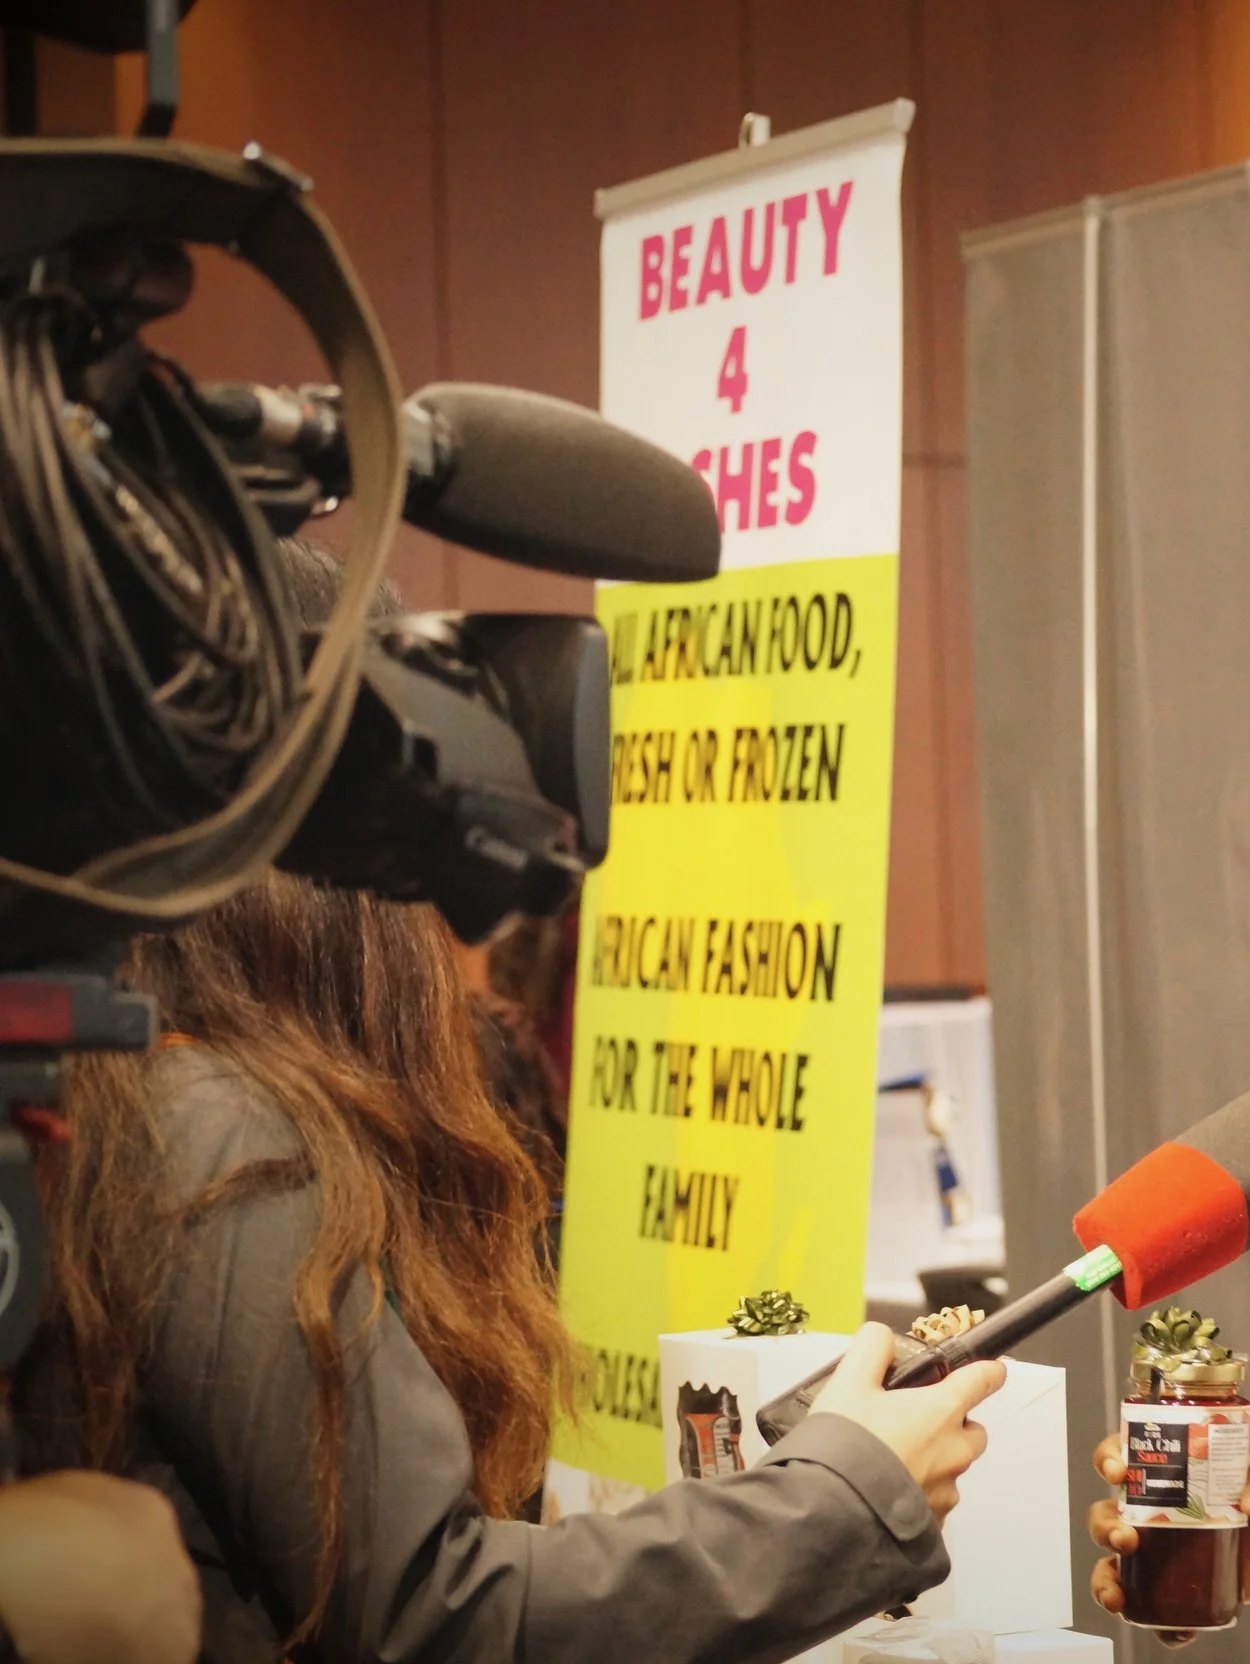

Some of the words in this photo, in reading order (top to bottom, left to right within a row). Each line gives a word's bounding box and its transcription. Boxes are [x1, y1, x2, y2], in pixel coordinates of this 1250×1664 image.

[640, 180, 853, 321] BEAUTY
[718, 326, 748, 413] 4
[641, 599, 762, 682] AFRICAN
[766, 593, 861, 679] FOOD,
[684, 728, 719, 802] OR
[729, 724, 845, 803] FROZEN
[701, 919, 841, 1001] FASHION
[590, 1036, 639, 1111] FOR
[650, 1041, 699, 1117] THE
[710, 1047, 808, 1132] WHOLE
[640, 1165, 739, 1251] FAMILY
